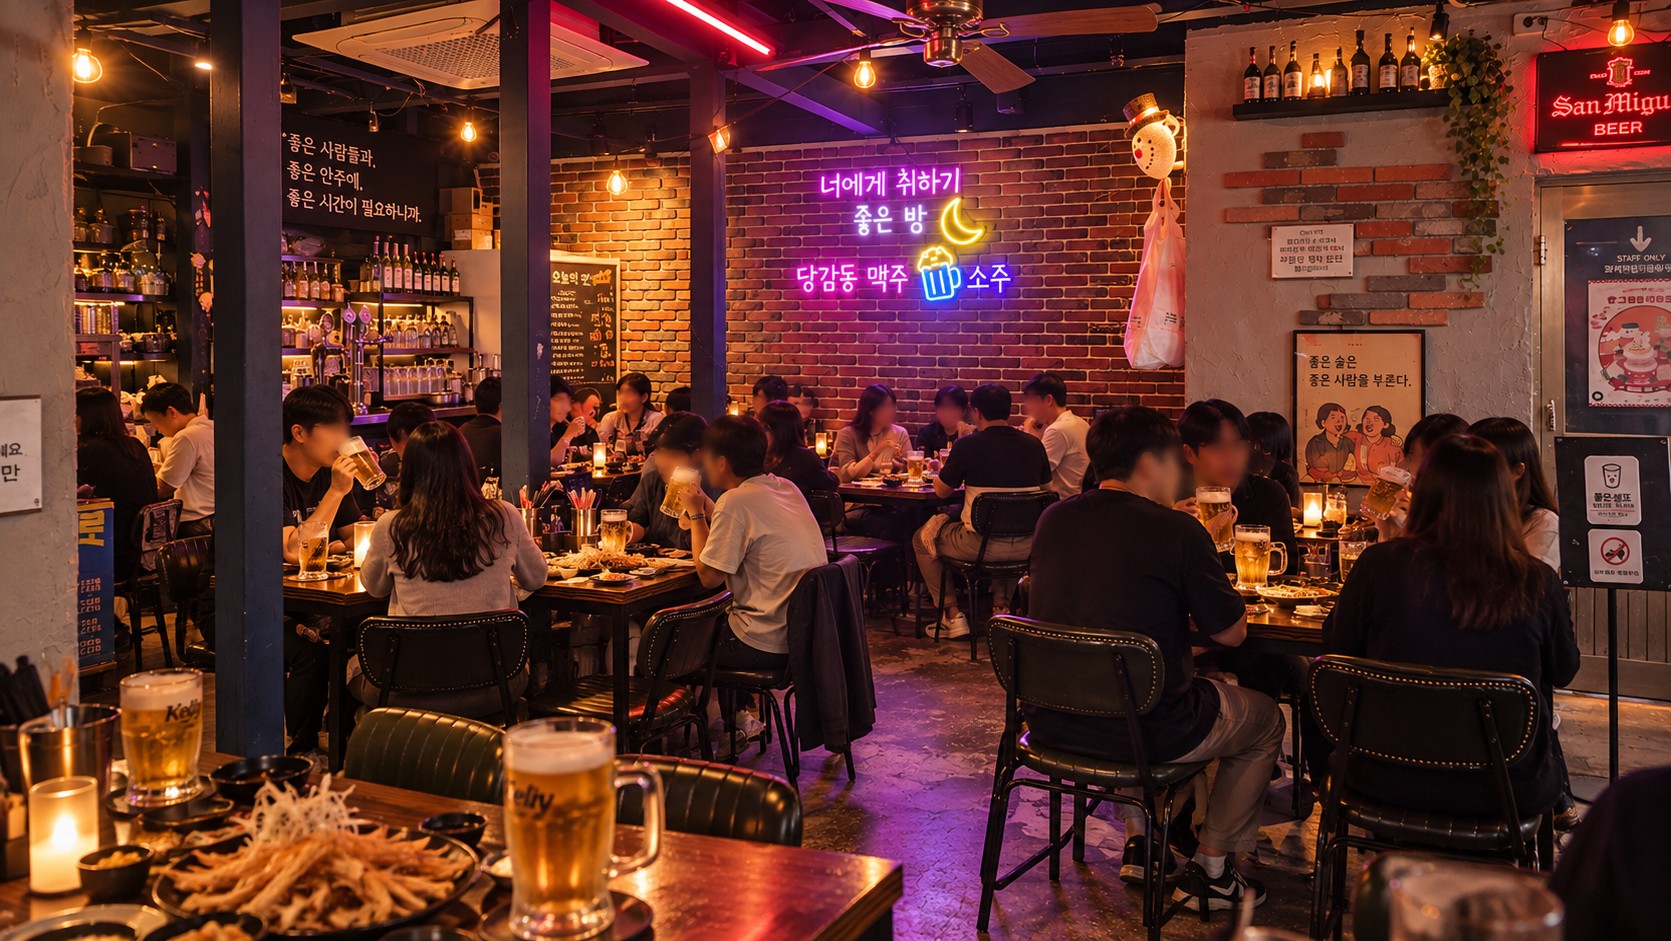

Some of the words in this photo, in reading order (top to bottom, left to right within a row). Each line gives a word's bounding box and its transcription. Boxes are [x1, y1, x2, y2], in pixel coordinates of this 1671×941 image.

[1551, 95, 1601, 117] San
[1594, 121, 1642, 135] BEER
[287, 133, 316, 155] 좋은
[286, 160, 316, 182] 좋은
[820, 171, 886, 198] 너에게
[896, 167, 960, 196] 취하기
[286, 188, 316, 209] 좋은
[319, 193, 358, 215] 시간이
[361, 199, 422, 223] 필요하니까.
[853, 205, 893, 236] 좋은
[904, 204, 927, 234] 방
[1616, 254, 1642, 262] STAFF
[796, 263, 858, 293] 당감동
[867, 264, 909, 294] 맥주
[966, 264, 1011, 294] 소주
[1334, 355, 1357, 369] 술은
[1334, 373, 1369, 387] 사람을
